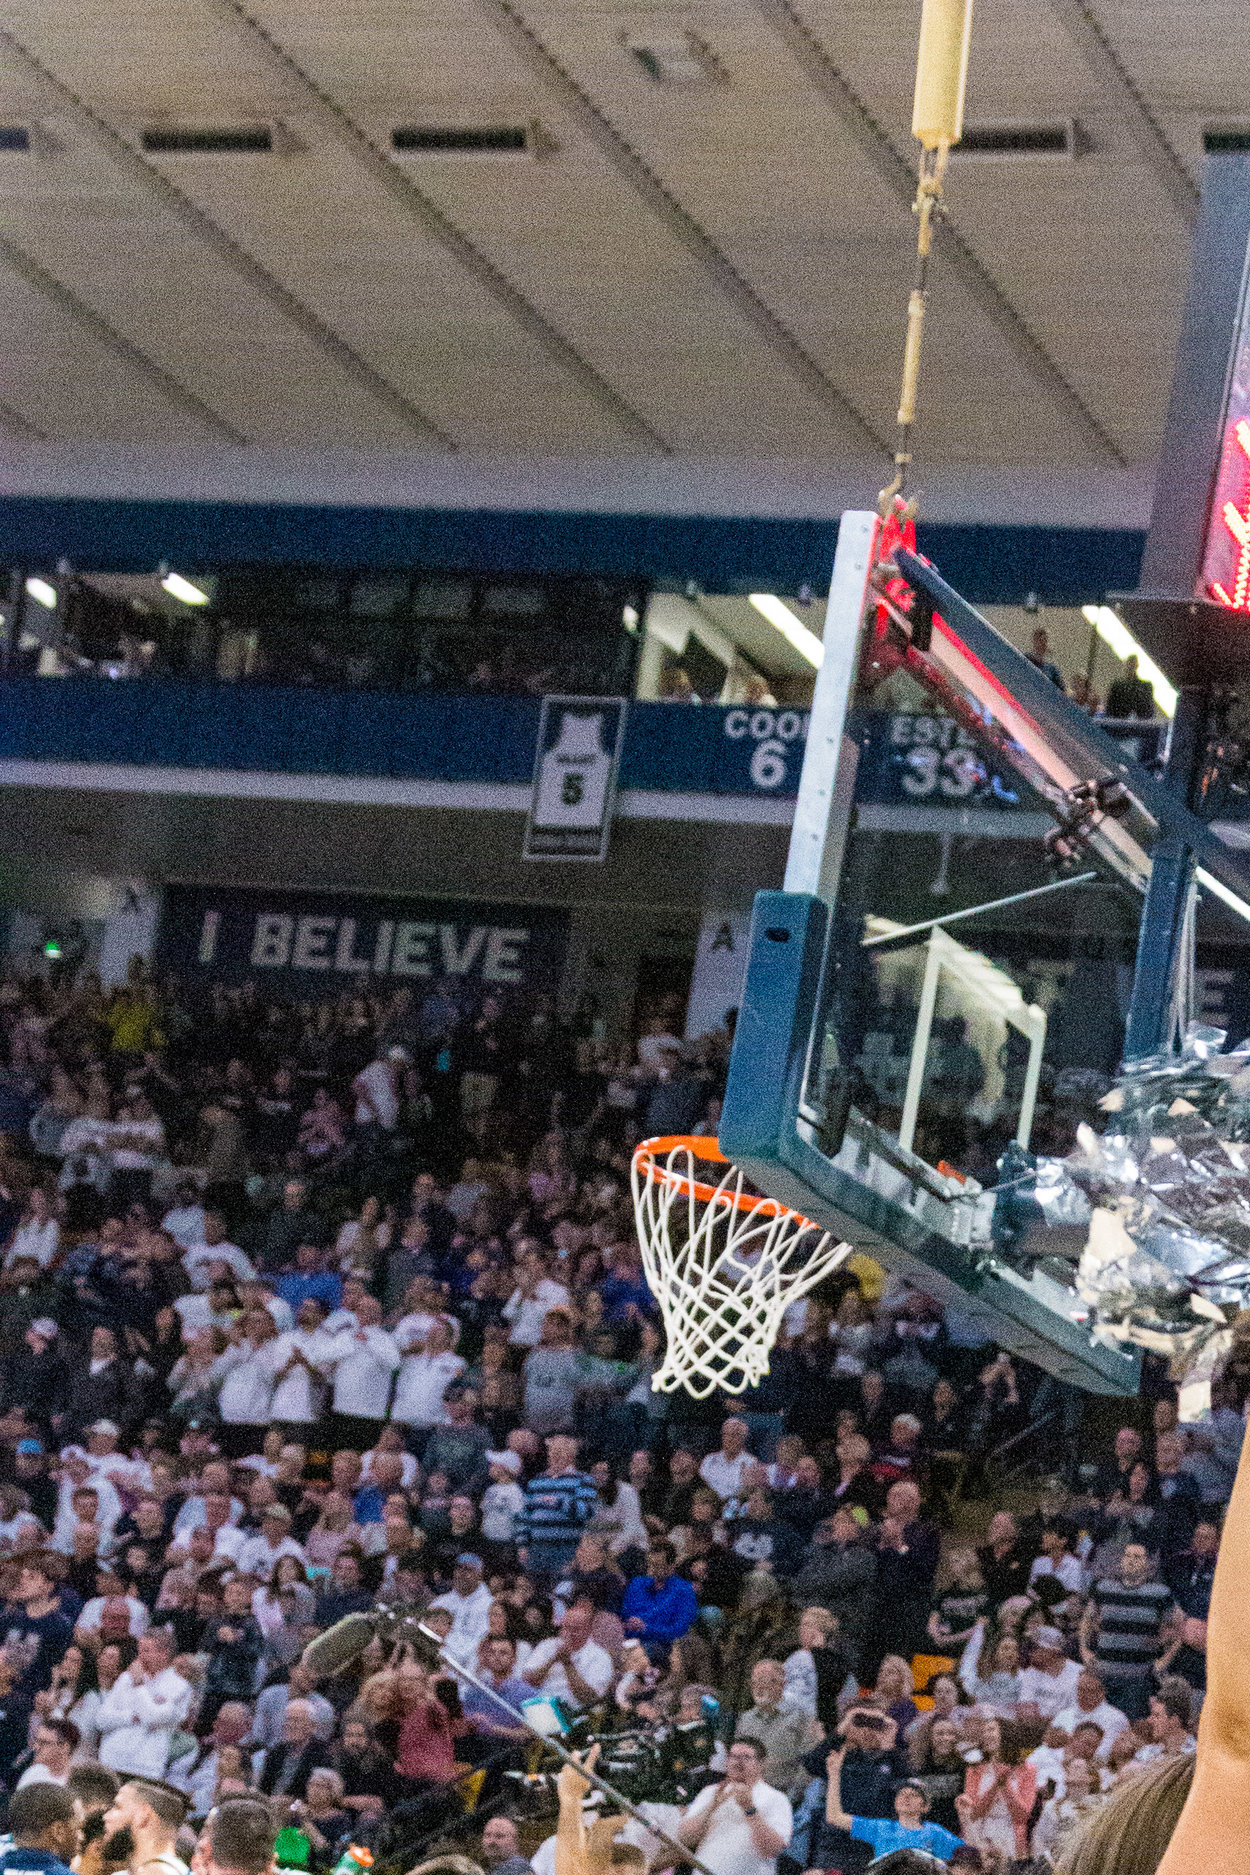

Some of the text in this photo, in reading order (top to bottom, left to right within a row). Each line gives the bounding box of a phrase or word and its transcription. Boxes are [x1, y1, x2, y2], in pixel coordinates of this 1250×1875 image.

[724, 710, 811, 740] COO
[750, 741, 788, 788] 6
[902, 747, 980, 796] 33
[562, 773, 585, 806] 5
[199, 911, 530, 981] I BELIEVE
[709, 922, 736, 951] A
